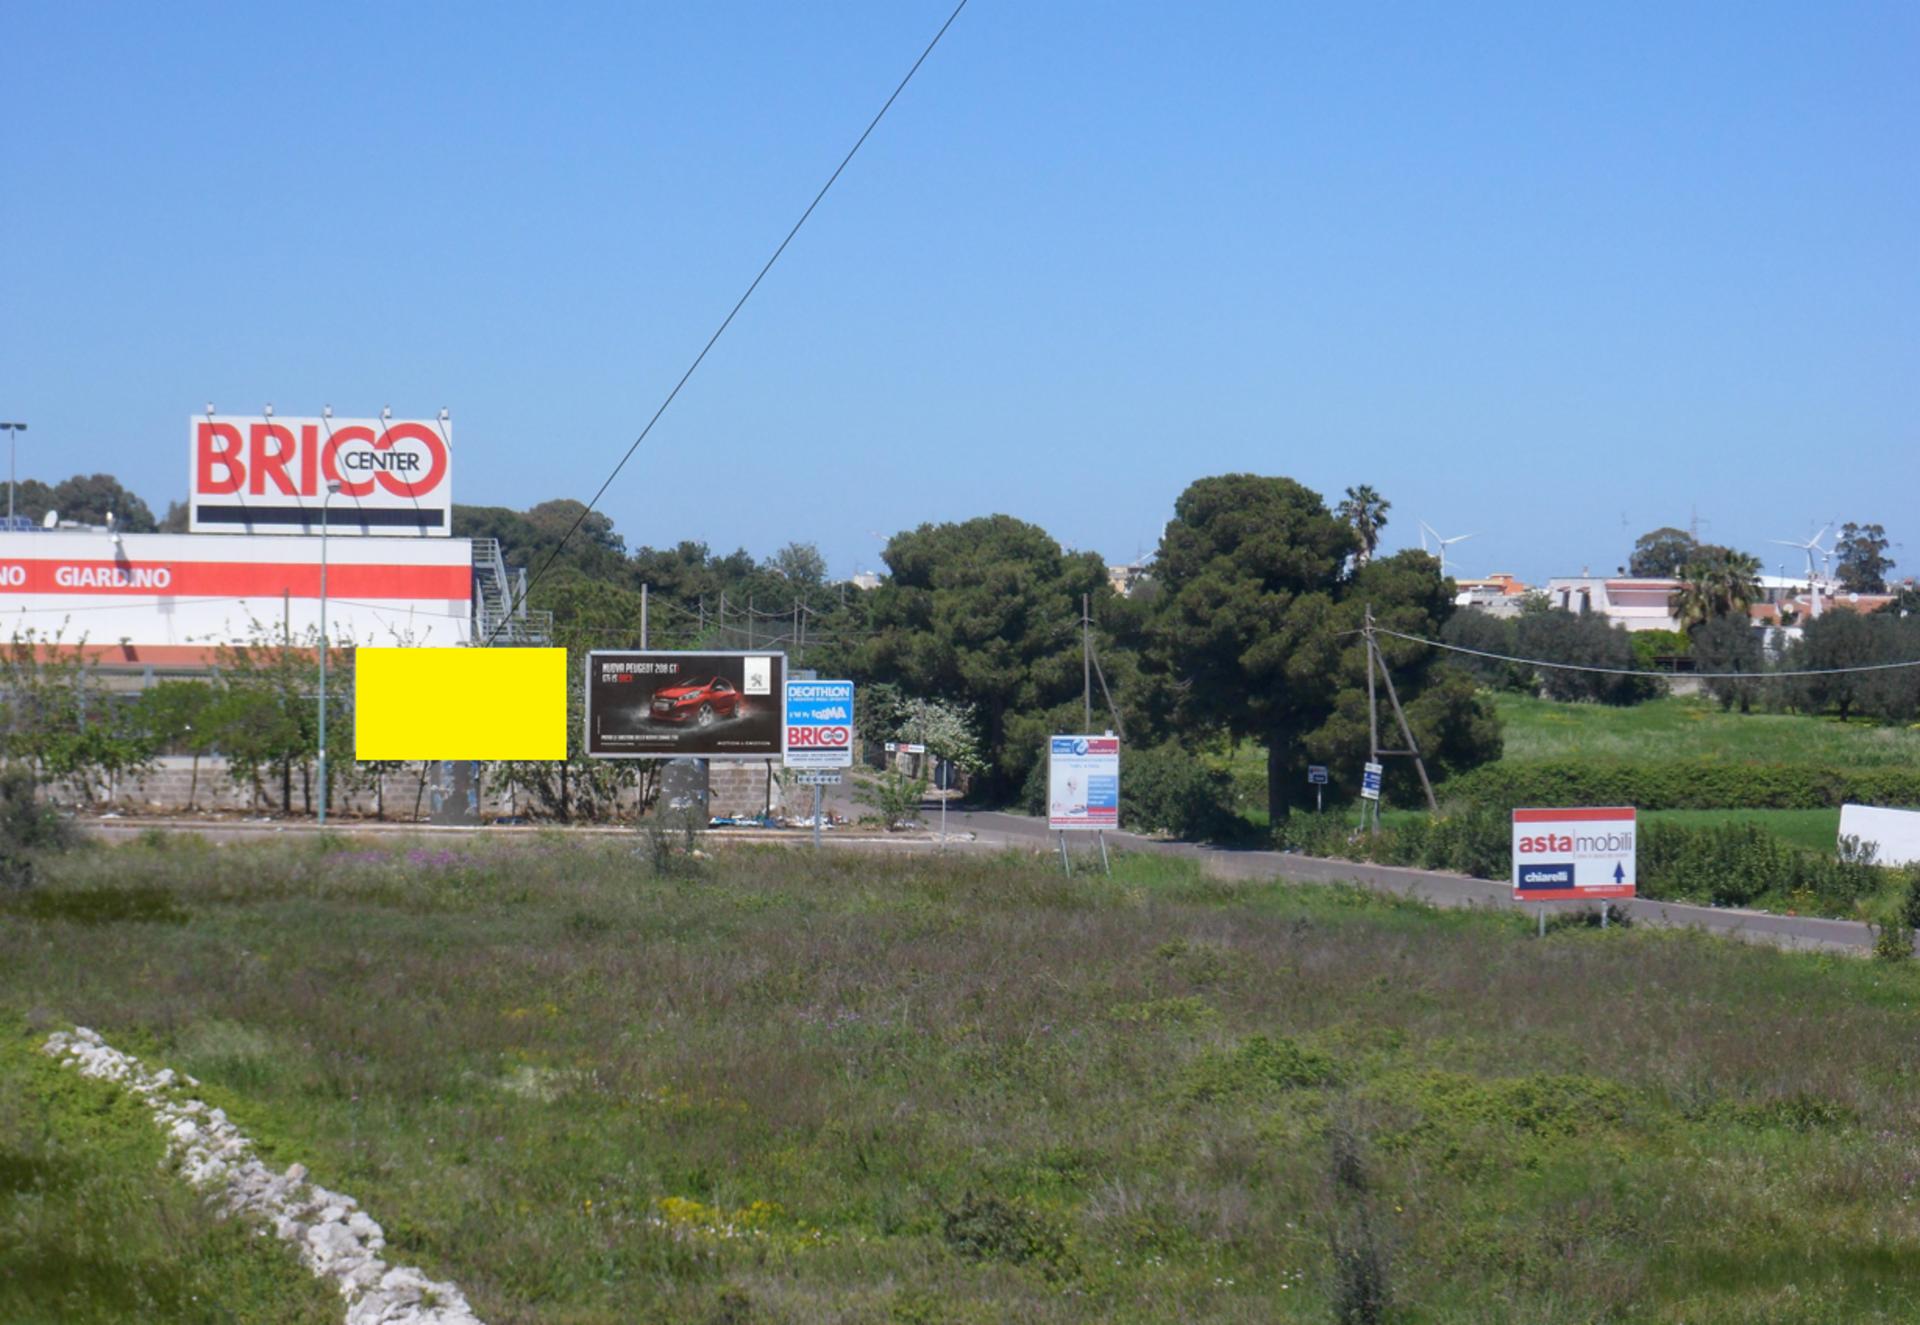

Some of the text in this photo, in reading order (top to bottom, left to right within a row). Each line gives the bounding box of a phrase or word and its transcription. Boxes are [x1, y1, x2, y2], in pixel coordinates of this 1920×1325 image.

[196, 422, 448, 498] BRICO
[345, 451, 421, 471] CENTER
[54, 565, 172, 588] GIARDINO
[625, 662, 654, 674] PEUGEOT
[788, 686, 850, 697] DECATHLON
[788, 726, 849, 746] BRICO
[1519, 832, 1632, 853] asta mobili
[1524, 871, 1569, 883] chiarelli
